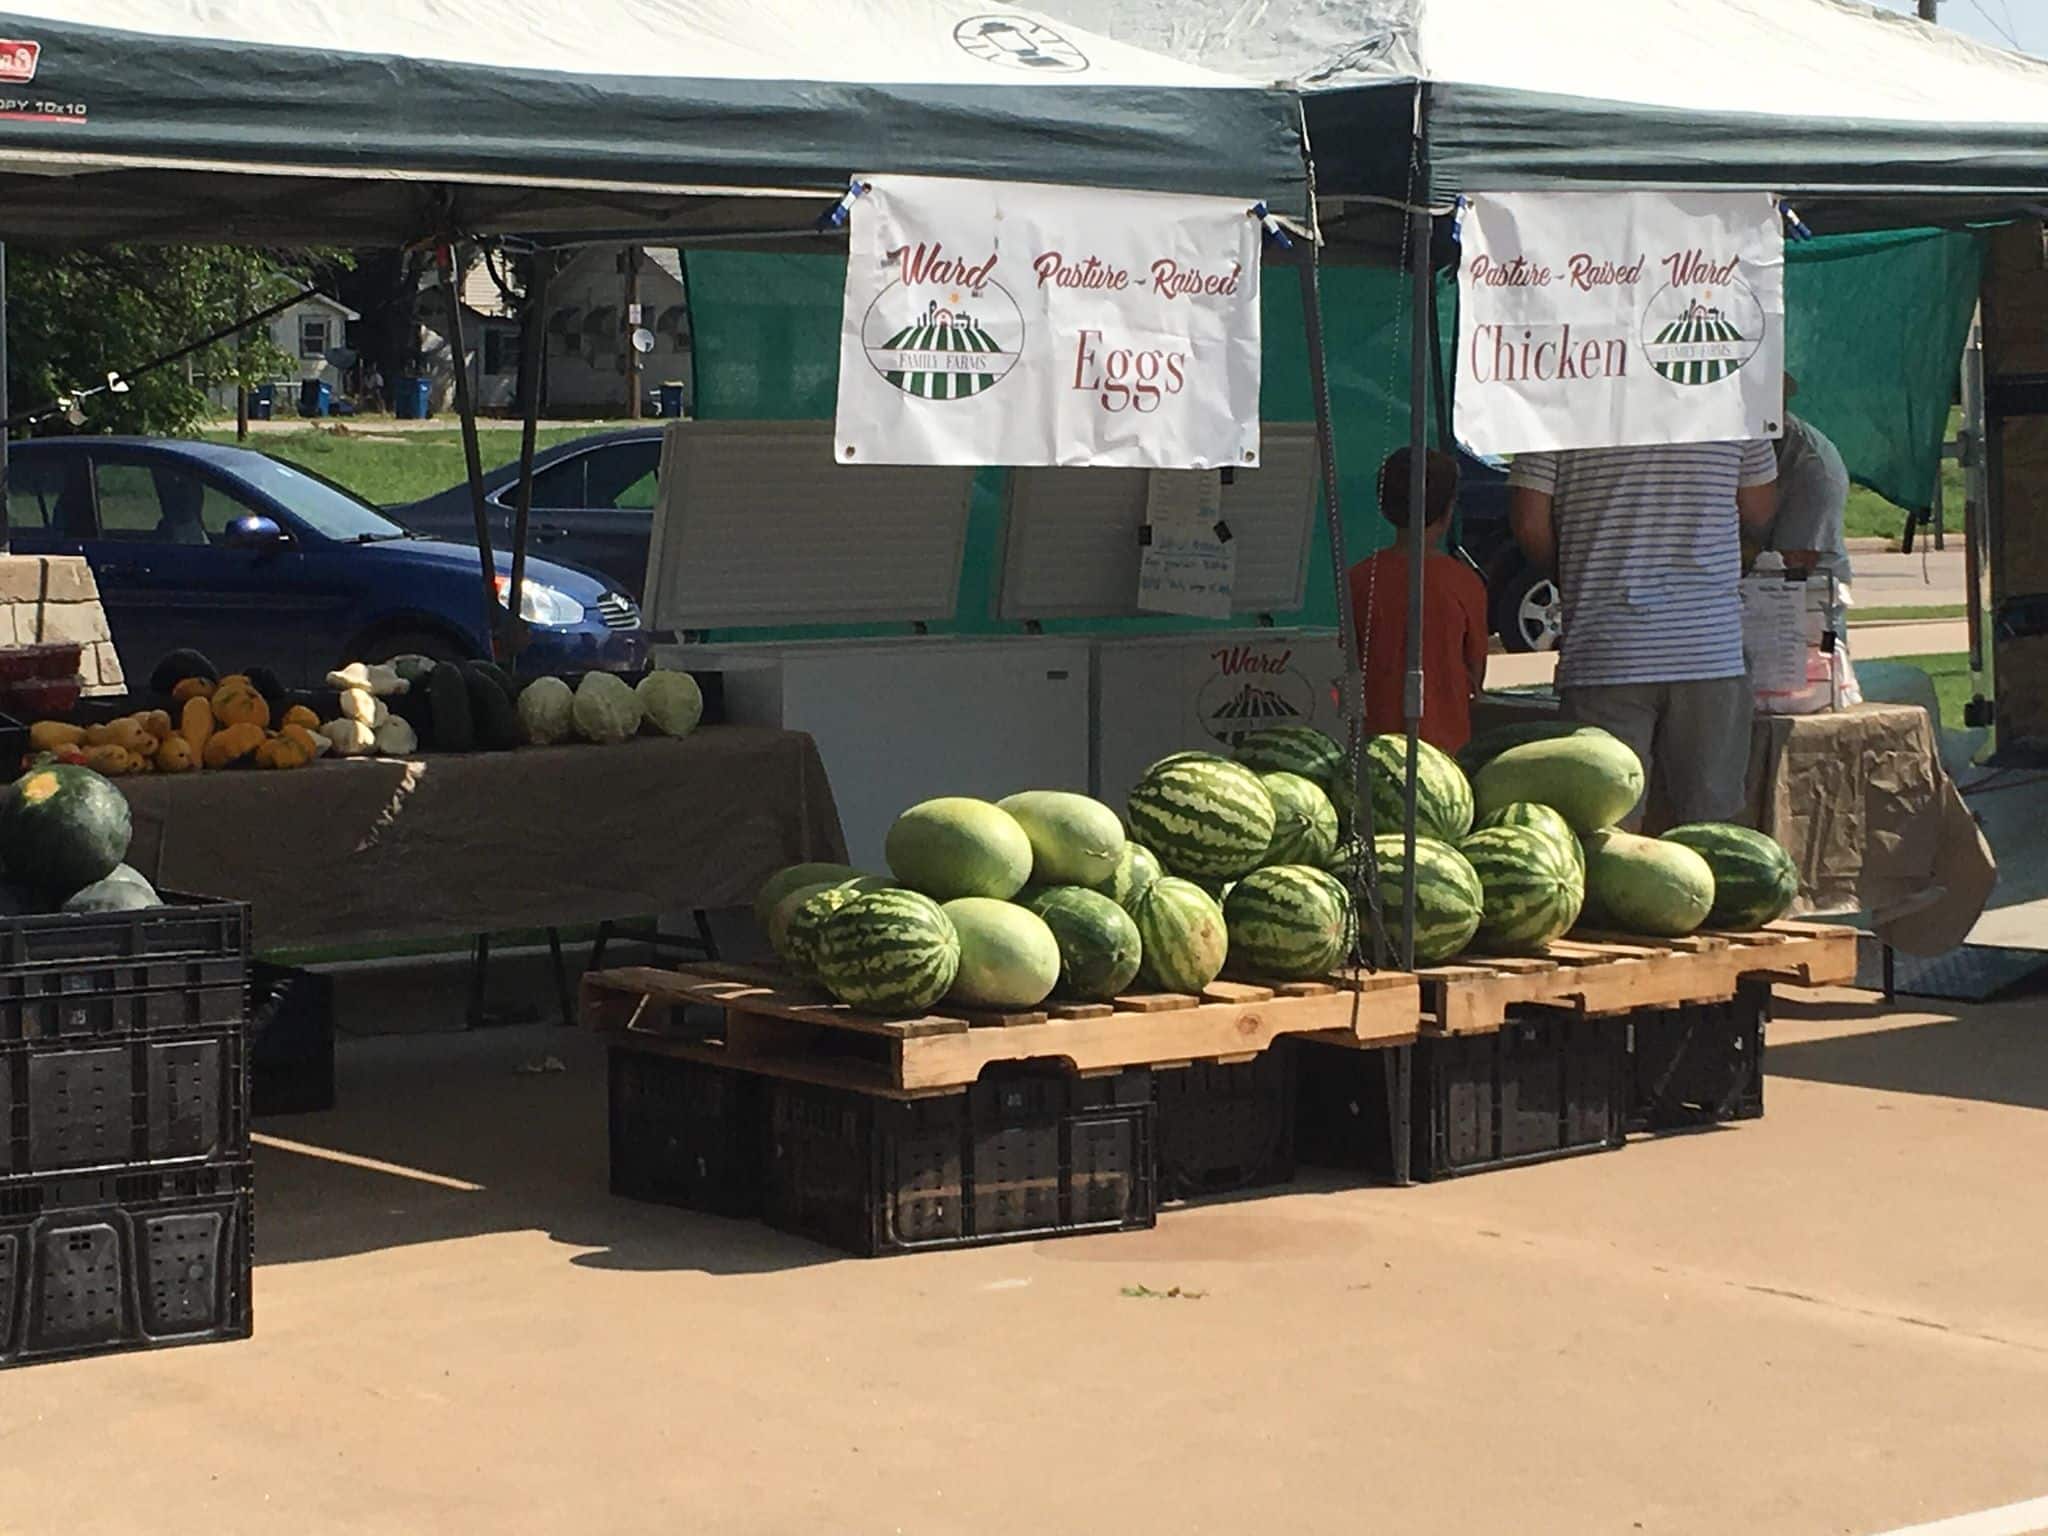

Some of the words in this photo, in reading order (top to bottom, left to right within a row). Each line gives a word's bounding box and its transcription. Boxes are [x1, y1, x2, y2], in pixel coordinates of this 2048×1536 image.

[886, 242, 998, 290] Ward
[1662, 248, 1740, 289] Ward
[946, 354, 987, 371] FARMS
[1072, 329, 1186, 413] Eggs
[1471, 323, 1628, 384] Chicken
[1211, 647, 1291, 676] Ward
